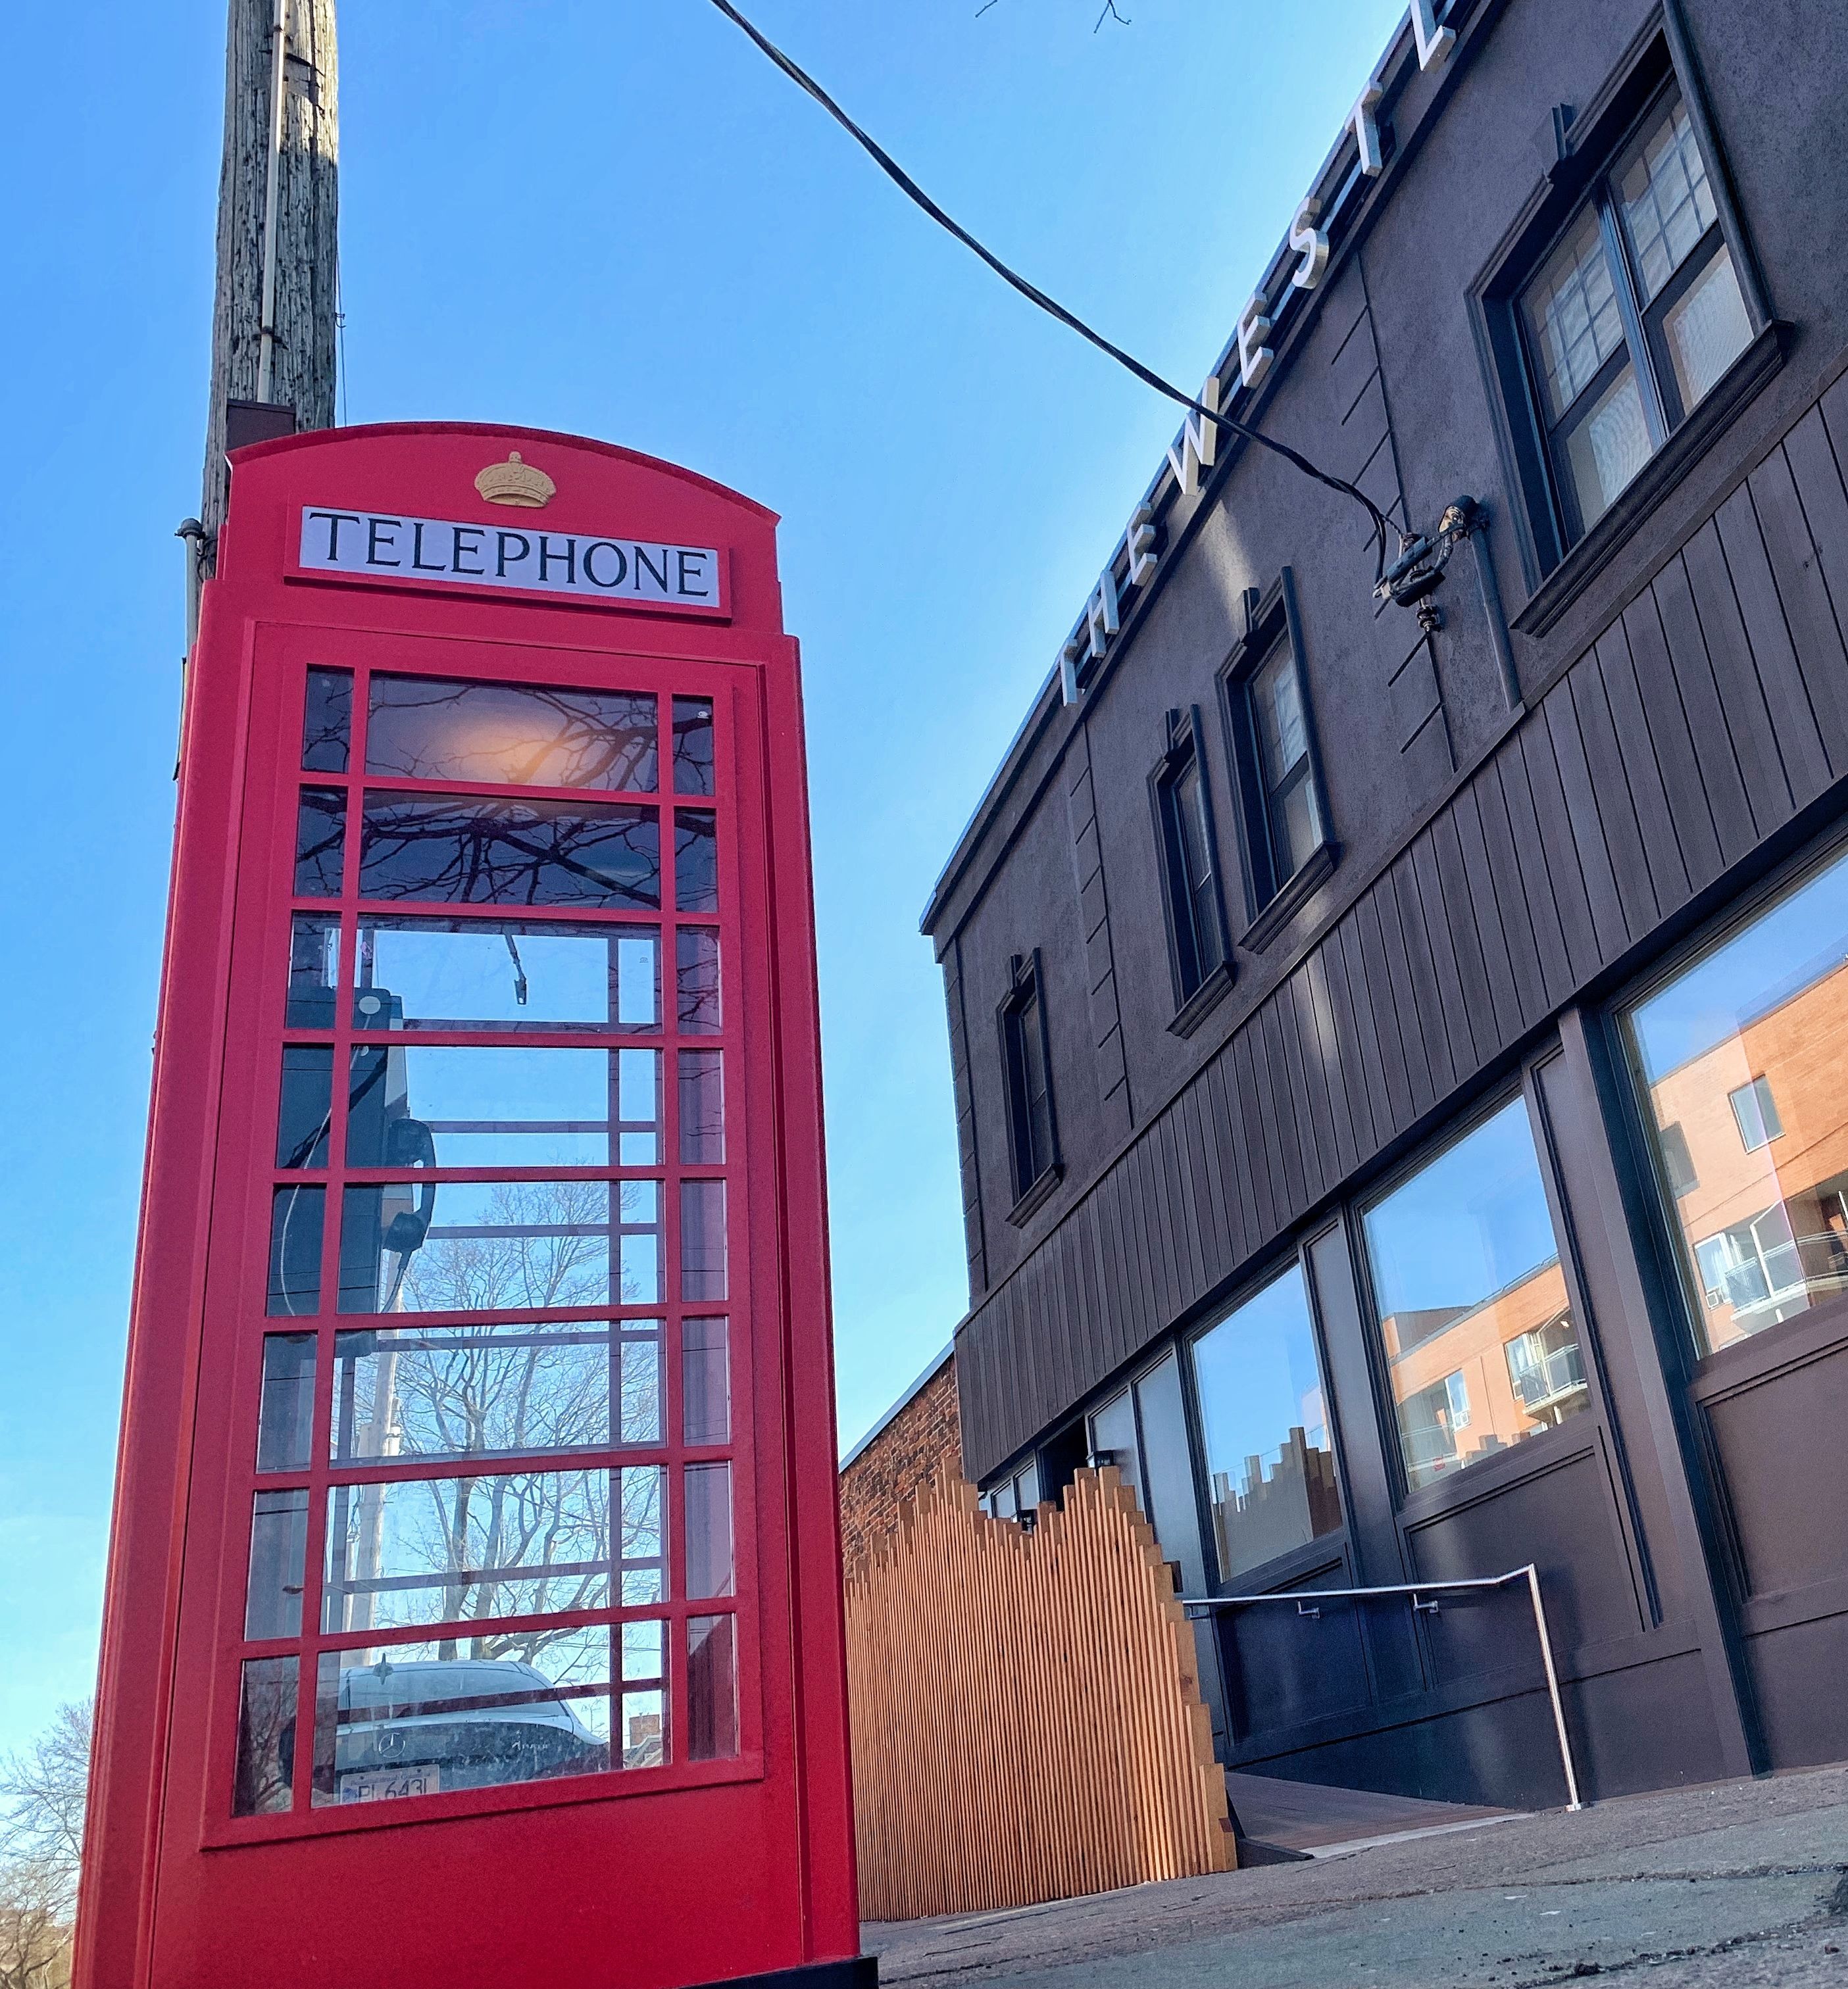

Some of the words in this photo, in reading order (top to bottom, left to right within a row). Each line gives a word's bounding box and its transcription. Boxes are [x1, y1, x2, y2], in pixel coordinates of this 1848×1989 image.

[309, 512, 709, 597] TELEPHONE
[1060, 500, 1158, 707] THE
[1167, 80, 1383, 497] WEST
